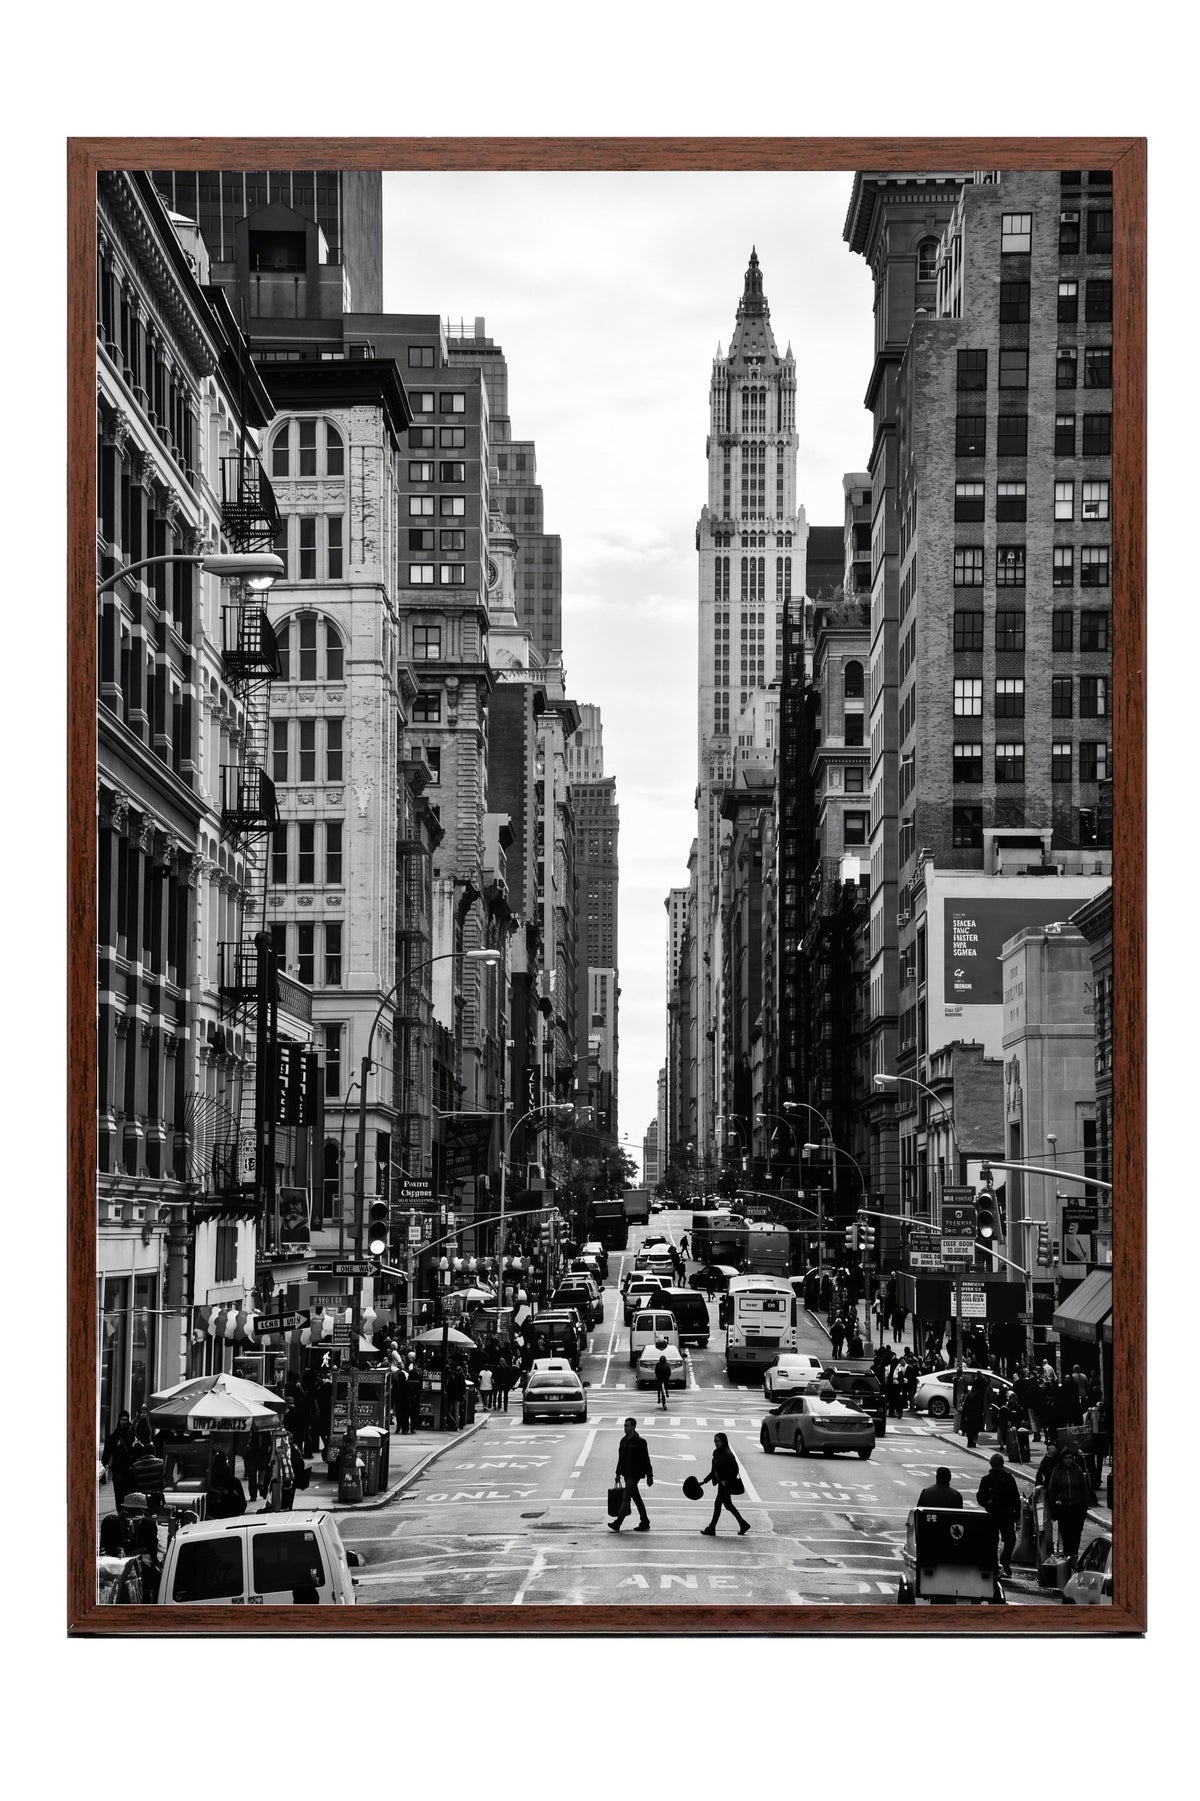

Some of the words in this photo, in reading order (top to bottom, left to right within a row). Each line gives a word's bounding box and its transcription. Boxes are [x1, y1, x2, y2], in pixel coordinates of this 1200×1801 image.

[341, 1265, 354, 1273] ONE
[359, 1265, 373, 1273] WAY
[455, 1461, 552, 1470] ONLY
[778, 1480, 875, 1491] ONLY
[425, 1489, 541, 1502] ONLY
[789, 1490, 879, 1502] BUS
